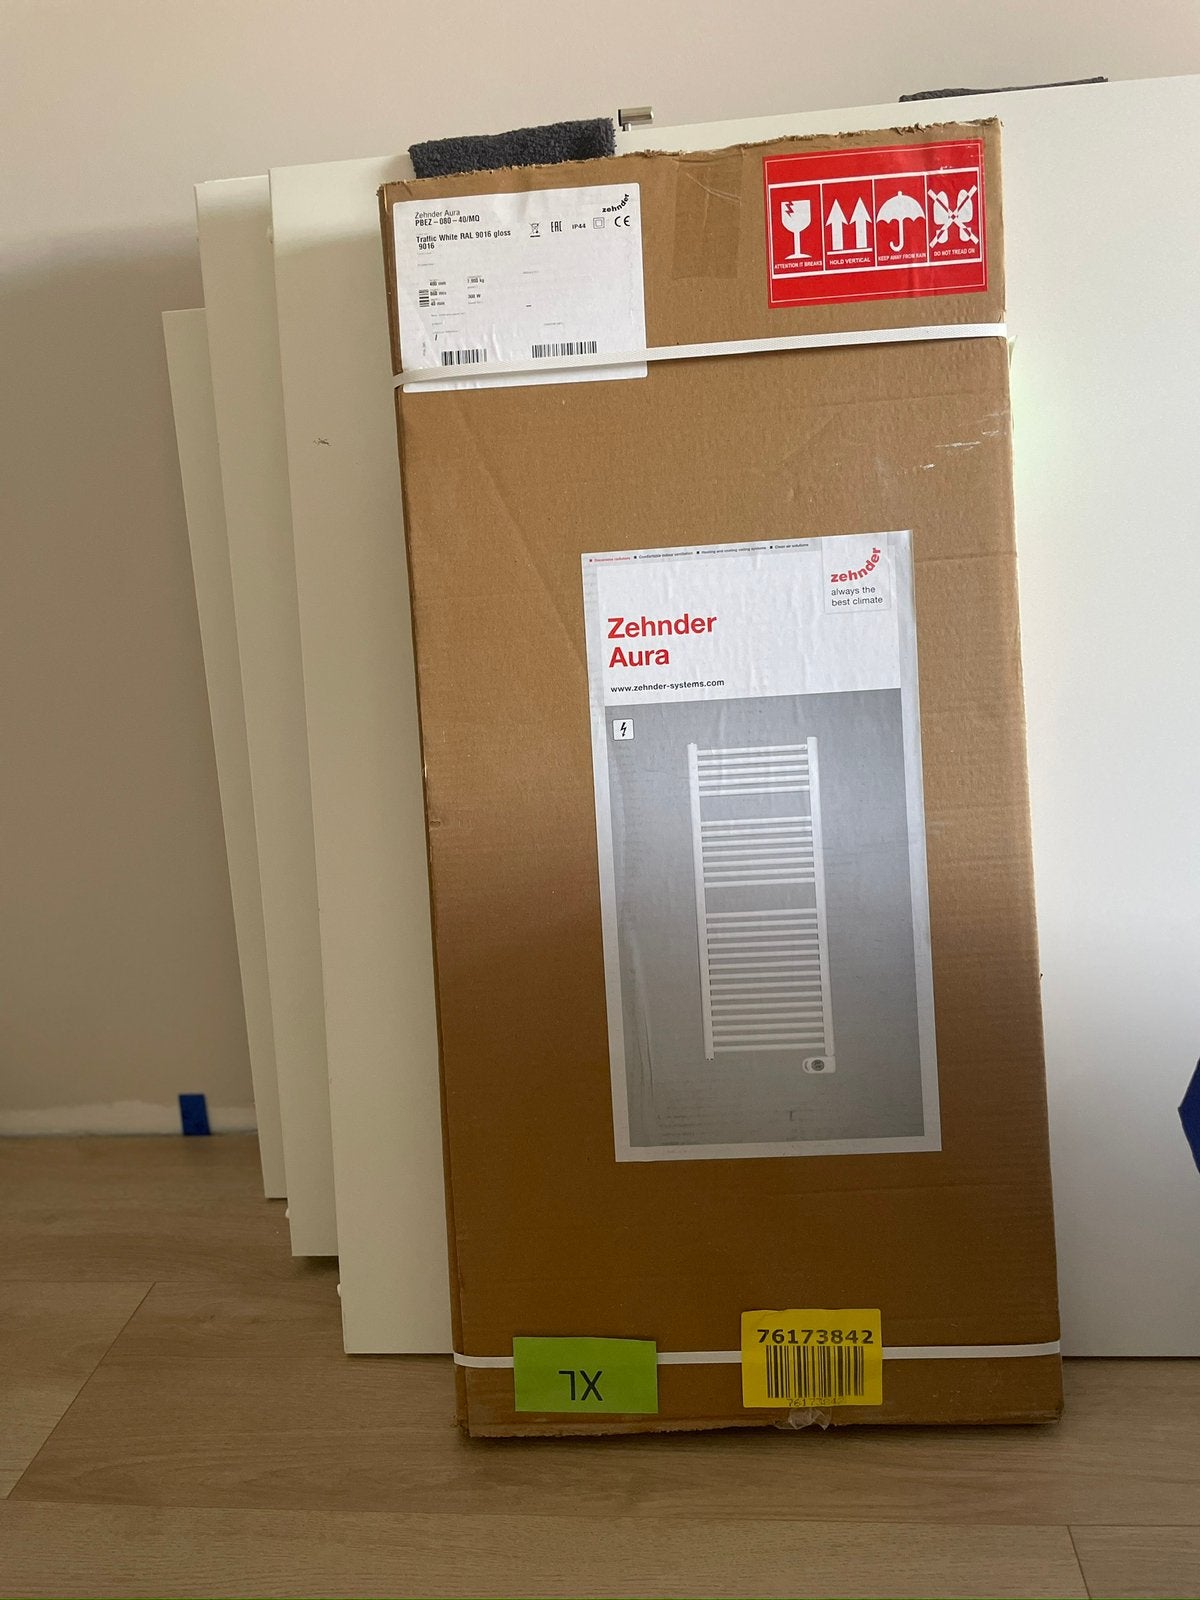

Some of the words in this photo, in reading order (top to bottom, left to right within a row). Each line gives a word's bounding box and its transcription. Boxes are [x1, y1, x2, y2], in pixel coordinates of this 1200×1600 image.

[602, 193, 630, 213] zehnder
[415, 211, 442, 219] Zehnder
[444, 209, 460, 217] Aura
[416, 235, 437, 243] Traffic
[439, 234, 458, 242] White
[460, 232, 473, 240] RAL
[476, 231, 491, 239] 9016
[493, 229, 511, 238] gloss
[830, 547, 881, 583] zehnder
[831, 587, 860, 596] always
[862, 586, 876, 594] the
[831, 598, 850, 607] best
[852, 596, 883, 605] climate
[608, 613, 718, 639] Zehnder
[608, 646, 670, 668] Aura
[610, 679, 725, 693] www.zehnder-systems.com
[757, 1328, 874, 1345] 76173842
